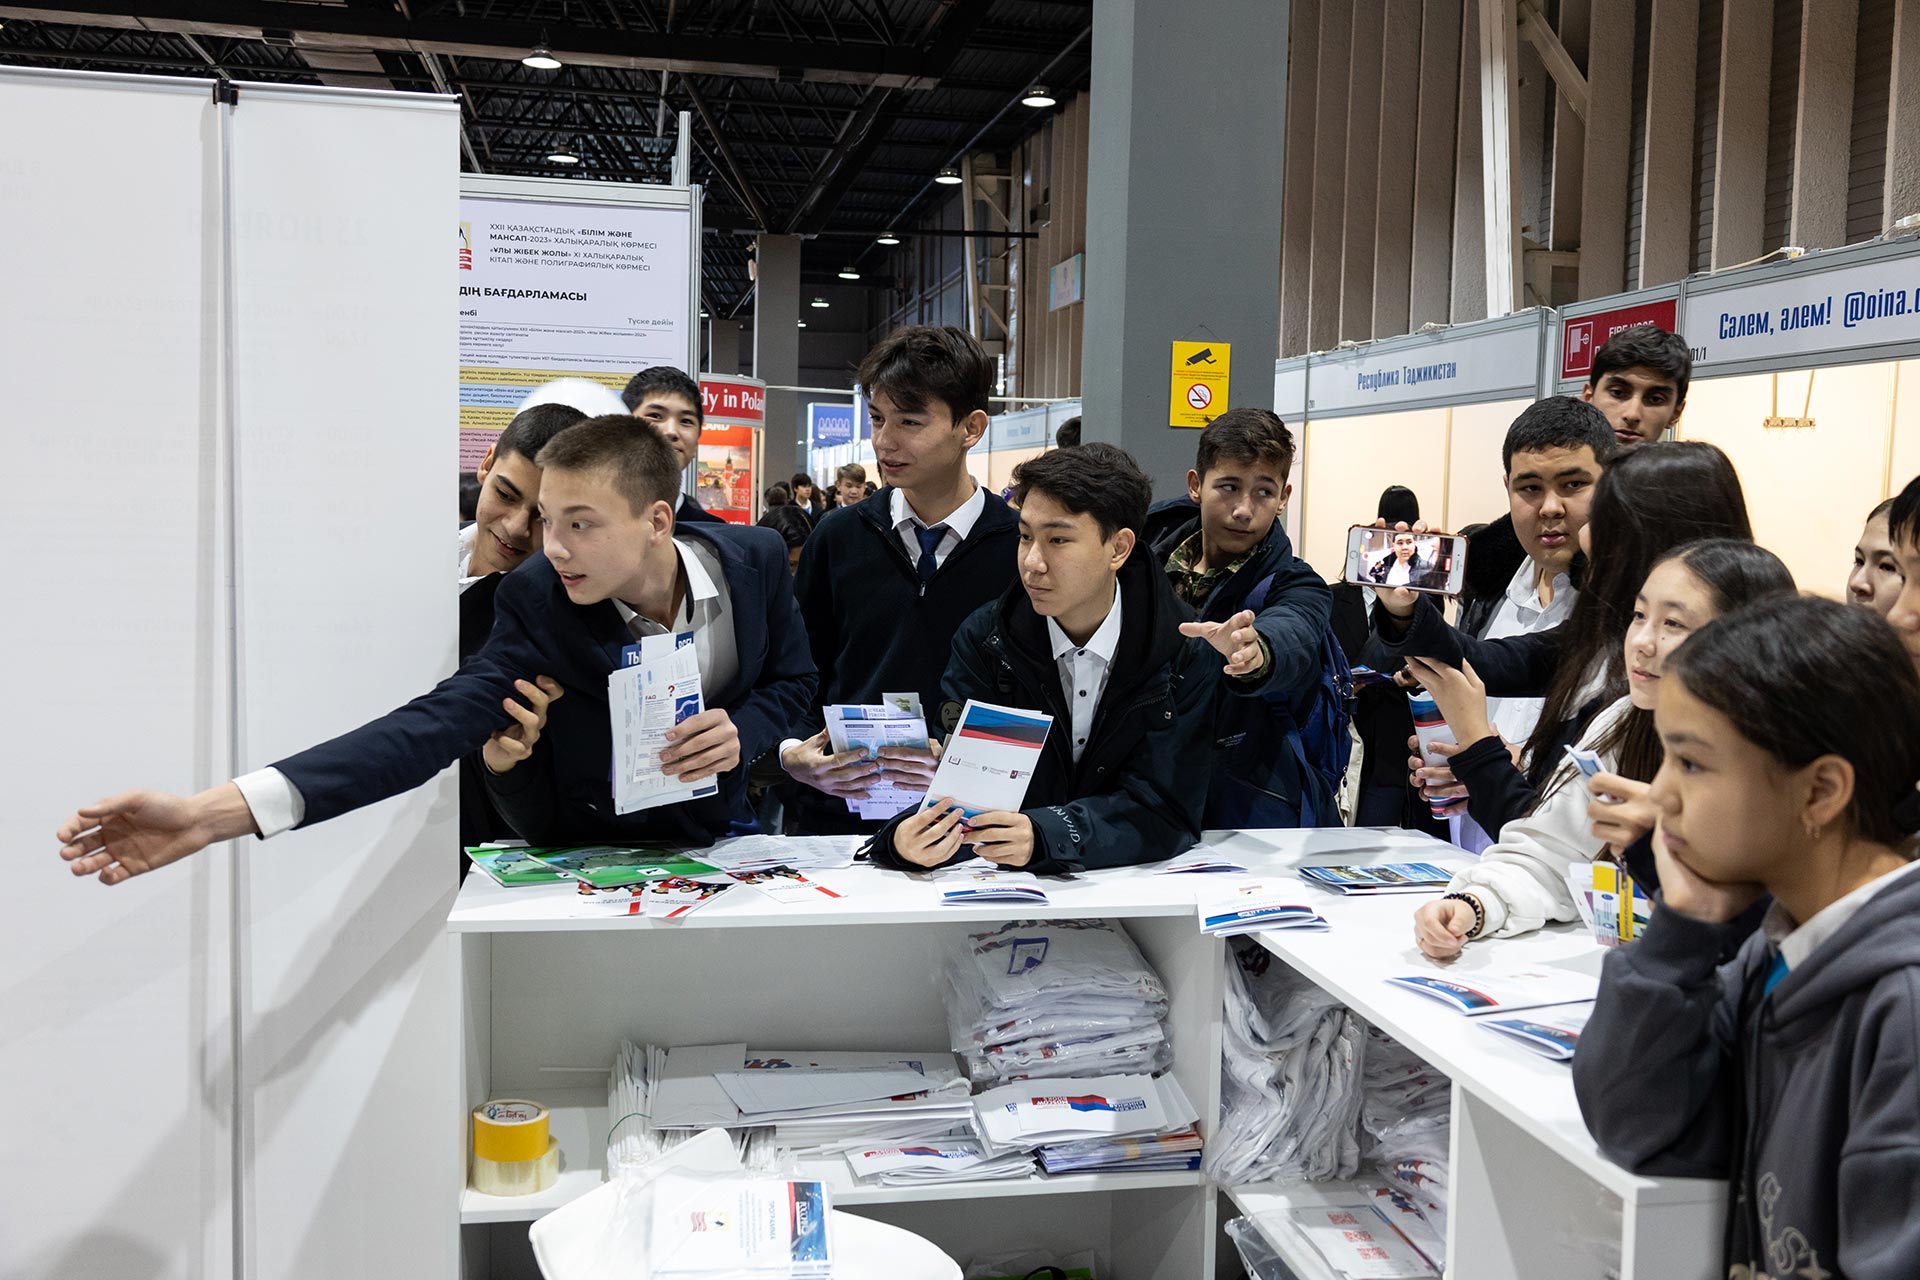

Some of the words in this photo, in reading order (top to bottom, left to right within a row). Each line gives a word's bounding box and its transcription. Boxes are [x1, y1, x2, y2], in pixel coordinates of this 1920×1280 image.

[507, 224, 576, 236] ҚАЗАҚСТАНДЫҚ
[577, 228, 605, 237] «БІЛІМ
[607, 230, 633, 239] ЖӘНЕ
[489, 233, 552, 244] МАНСАП-2023»
[554, 237, 619, 249] ХАЛЫҚАРАЛЫҚ
[620, 241, 657, 250] КӨРМЕСІ
[513, 248, 540, 256] ЖІБЕК
[541, 249, 572, 258] ЖОЛЫ»
[582, 252, 645, 263] ХАЛЫҚАРАЛЫҚ
[489, 256, 513, 264] КІТАП
[514, 257, 539, 266] ЖӘНЕ
[540, 259, 615, 271] ПОЛИГРАФИЯЛЫҚ
[615, 263, 651, 272] КӨРМЕСІ
[459, 286, 481, 298] ДІҢ
[484, 287, 587, 301] БАҒДАРЛАМАСЫ
[459, 309, 478, 317] енбі
[651, 318, 674, 327] дейін
[1357, 369, 1400, 393] Республика
[1402, 361, 1457, 387] Таджикистан
[723, 388, 737, 408] in
